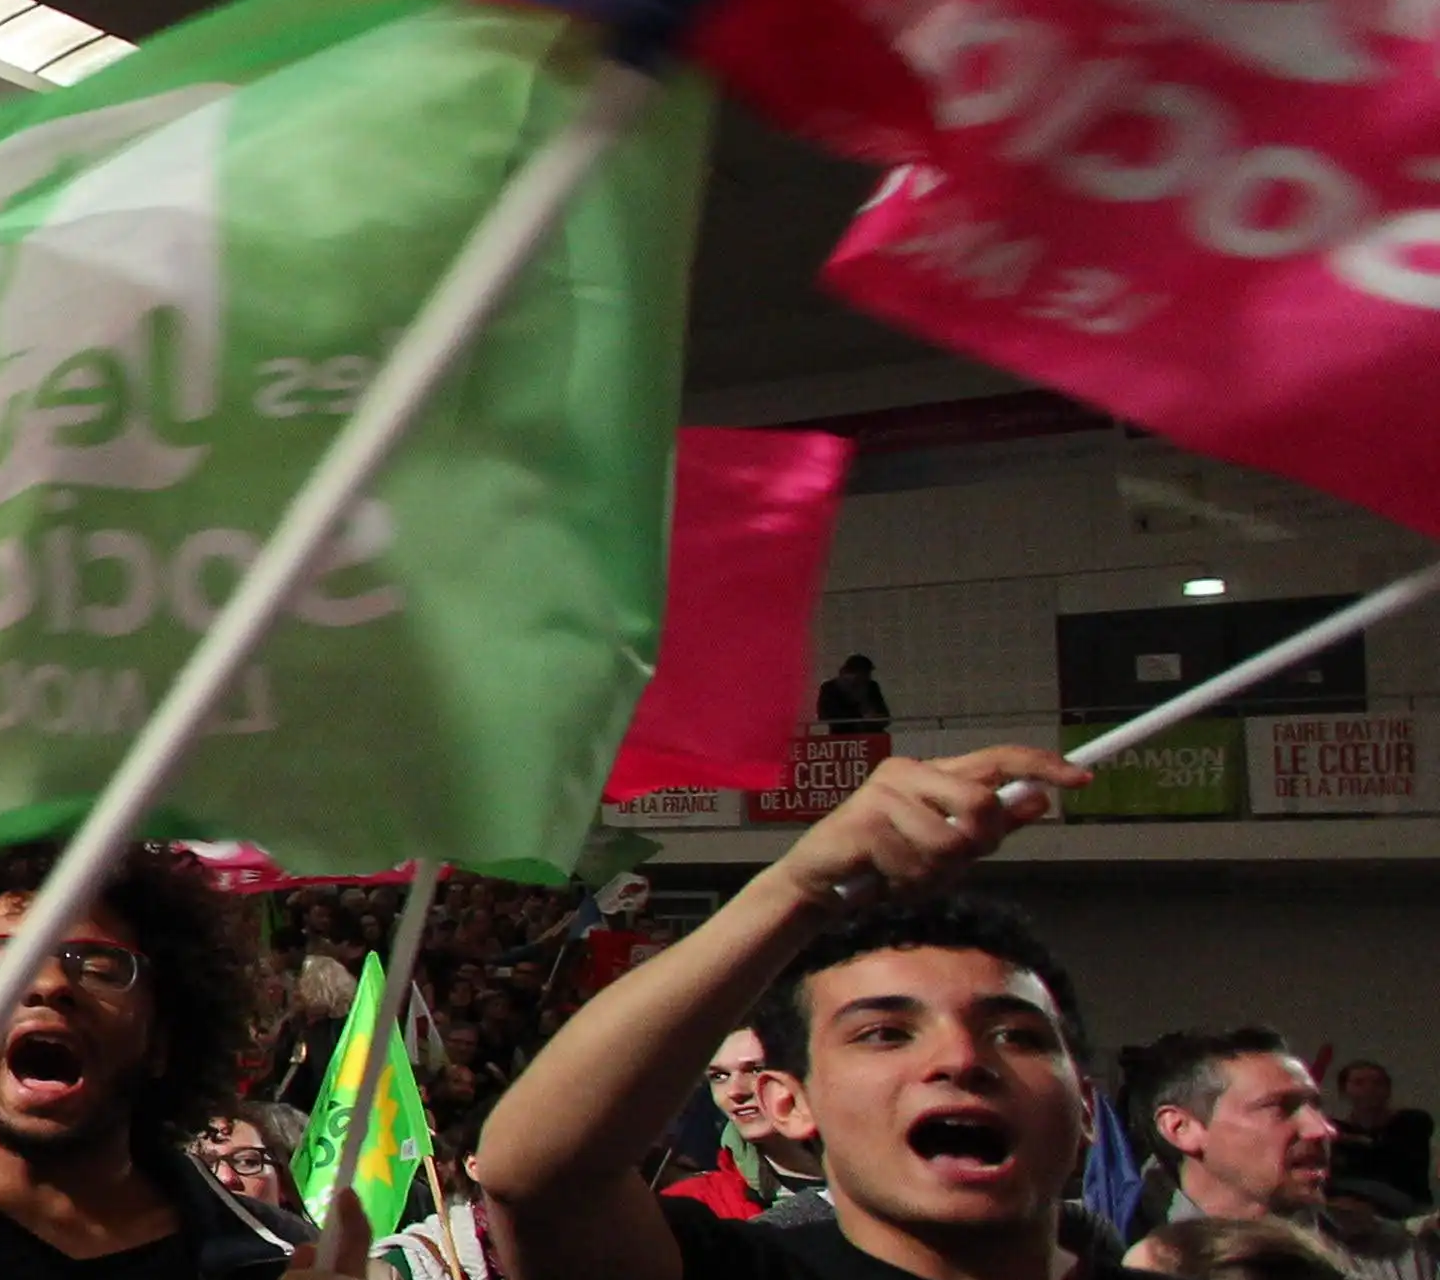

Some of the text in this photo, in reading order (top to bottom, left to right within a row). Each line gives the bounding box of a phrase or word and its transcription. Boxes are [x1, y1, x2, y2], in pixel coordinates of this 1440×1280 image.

[807, 740, 869, 761] BATTRE
[1274, 742, 1415, 776] LE CŒUR
[1157, 766, 1225, 788] 2017
[641, 796, 658, 814] LA
[662, 795, 719, 814] FRANCE
[760, 791, 781, 810] DE
[784, 791, 804, 810] LA
